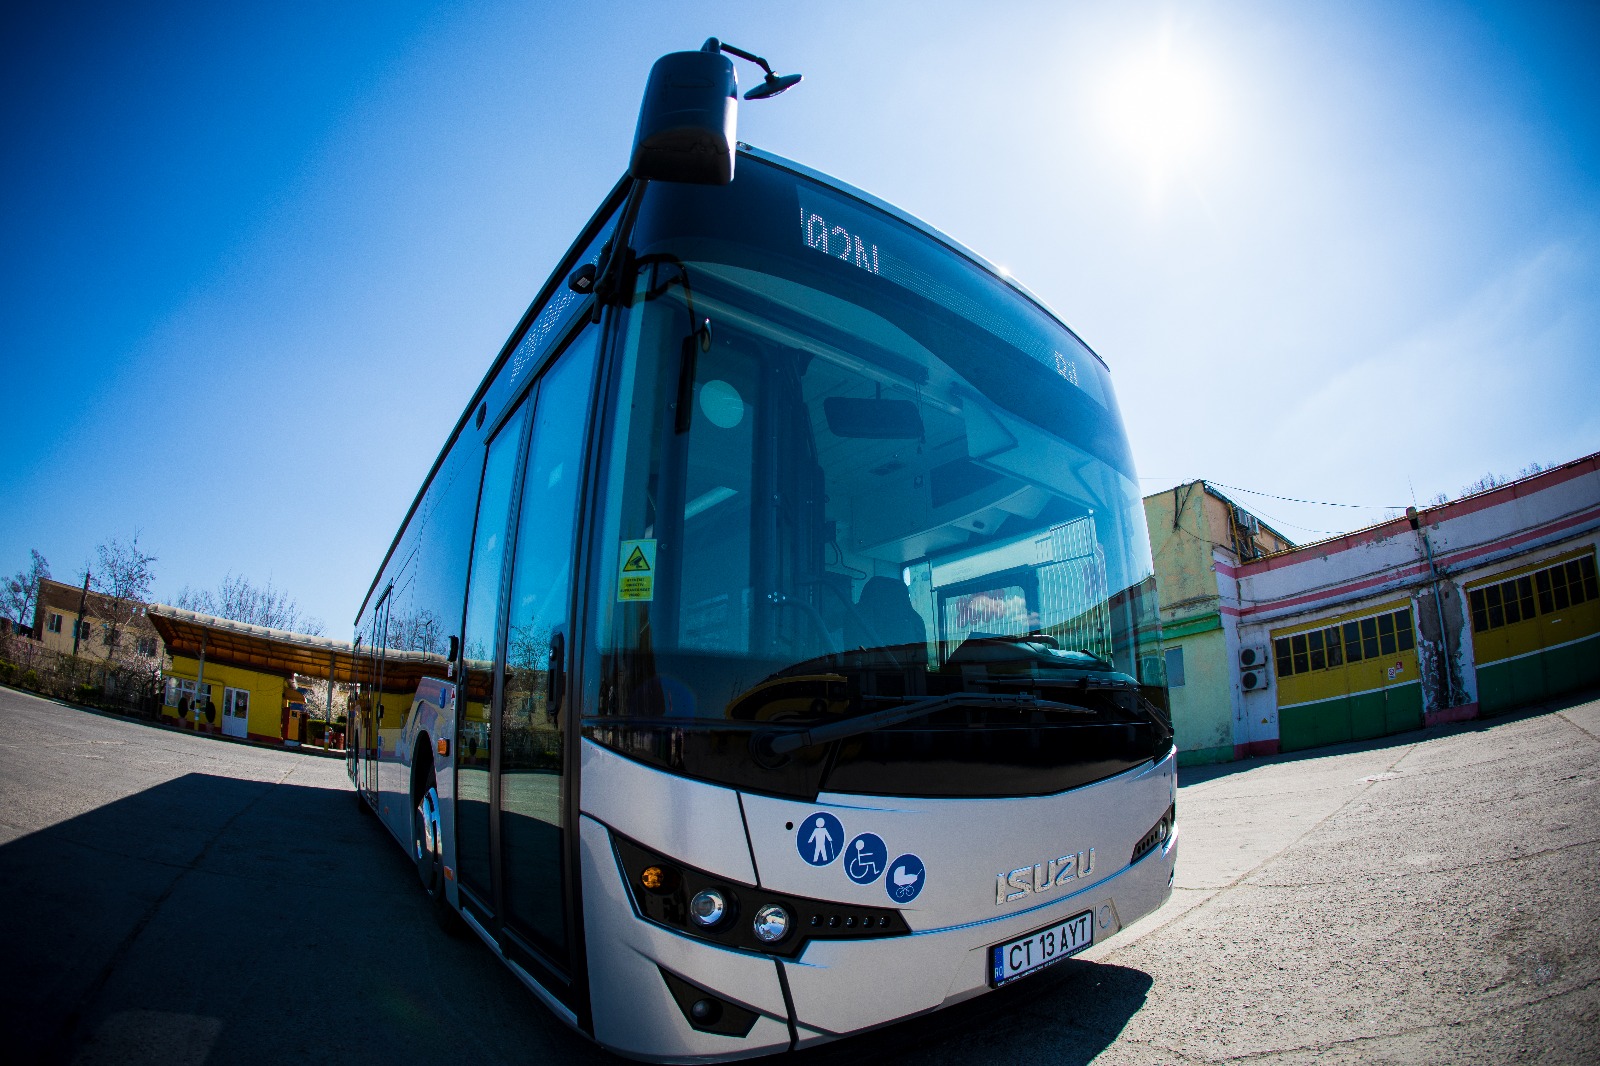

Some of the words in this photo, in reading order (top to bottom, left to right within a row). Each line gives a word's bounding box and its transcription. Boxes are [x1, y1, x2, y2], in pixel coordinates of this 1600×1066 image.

[995, 847, 1096, 906] ISUZU
[1009, 941, 1034, 971] CT
[1039, 931, 1055, 960] 13
[1059, 916, 1087, 953] AYT
